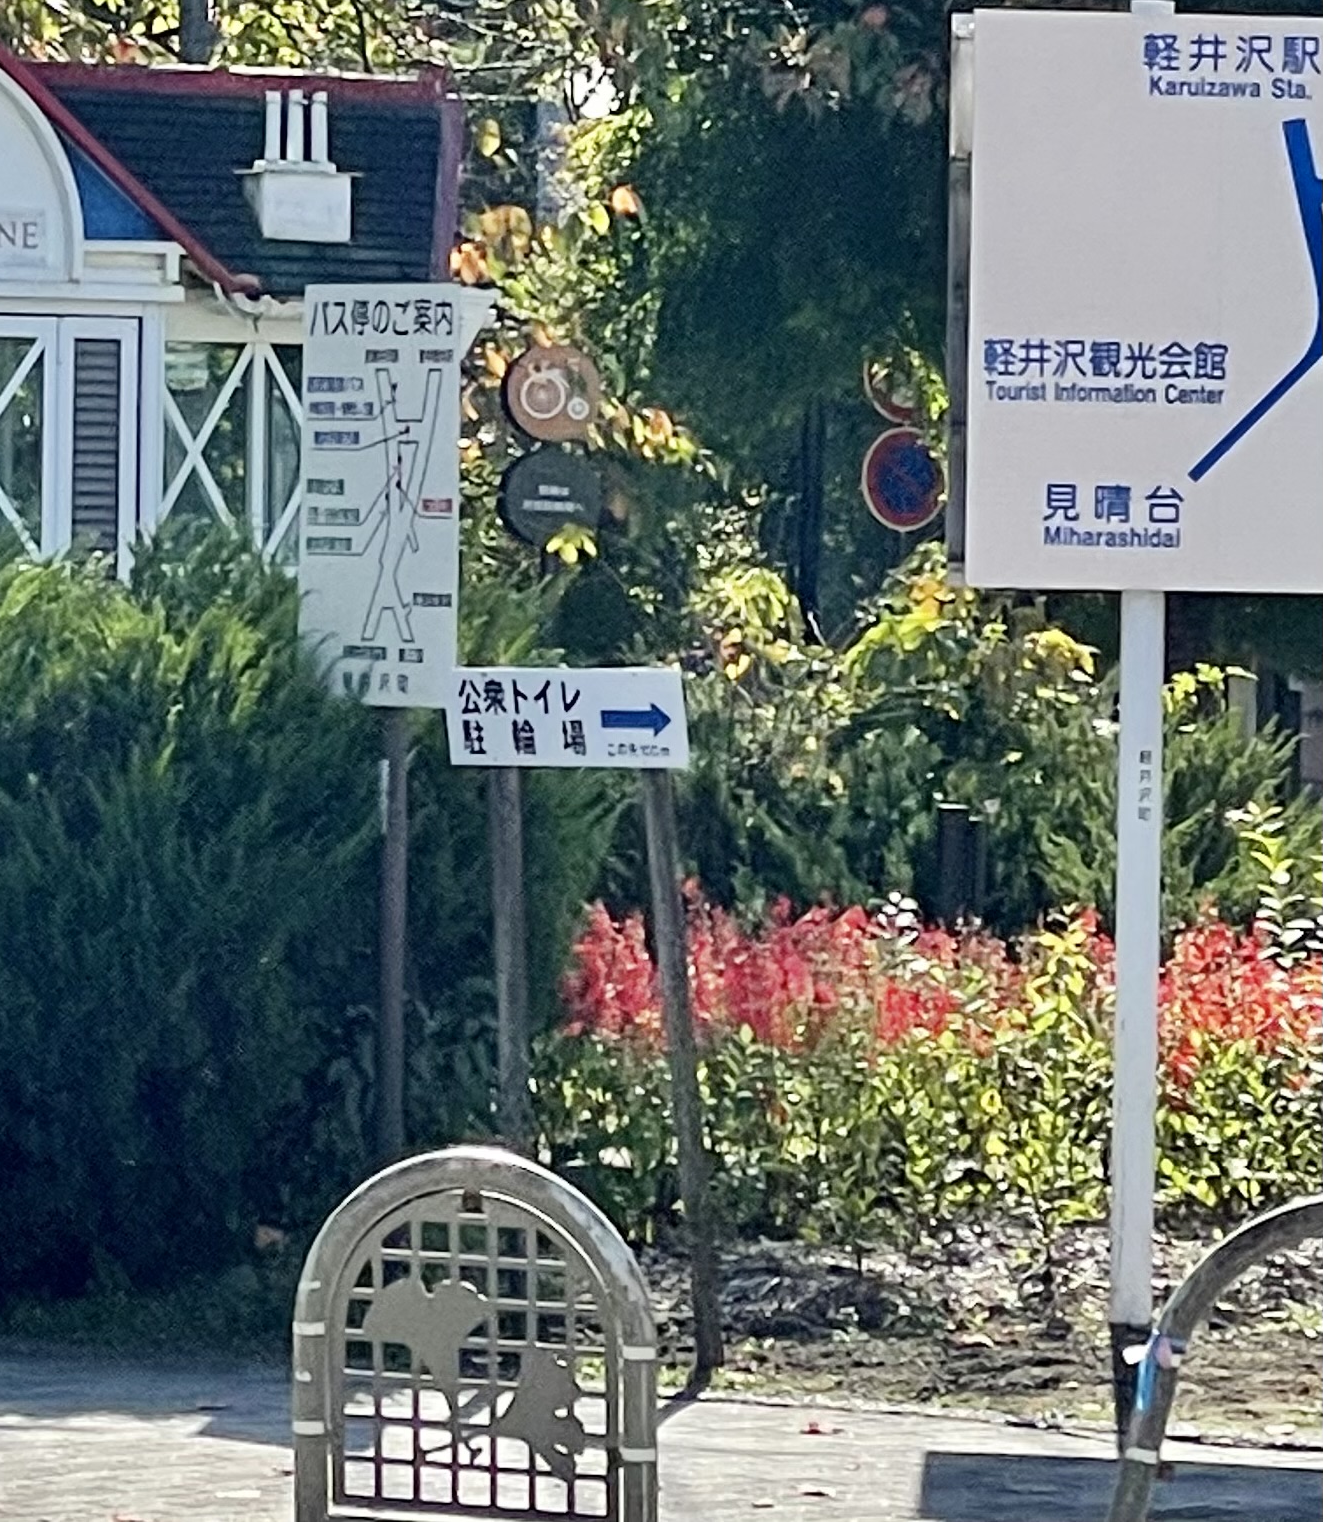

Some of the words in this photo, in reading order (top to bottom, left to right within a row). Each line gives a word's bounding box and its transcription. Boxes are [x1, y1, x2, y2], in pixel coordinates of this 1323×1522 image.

[1143, 33, 1322, 75] 軽井沢駅
[1149, 76, 1261, 98] Karuizawa
[1271, 78, 1313, 100] Sta.
[310, 299, 453, 337] バス停のご案内
[983, 338, 1229, 380] 軽井沢観光会館
[985, 381, 1047, 402] Tourist
[1054, 382, 1157, 404] Information
[1164, 383, 1225, 405] Center
[1042, 483, 1185, 524] 見晴台
[1043, 526, 1181, 549] Miharashidai
[458, 678, 581, 715] 公衆トイレ
[462, 719, 587, 756] 駐輪場
